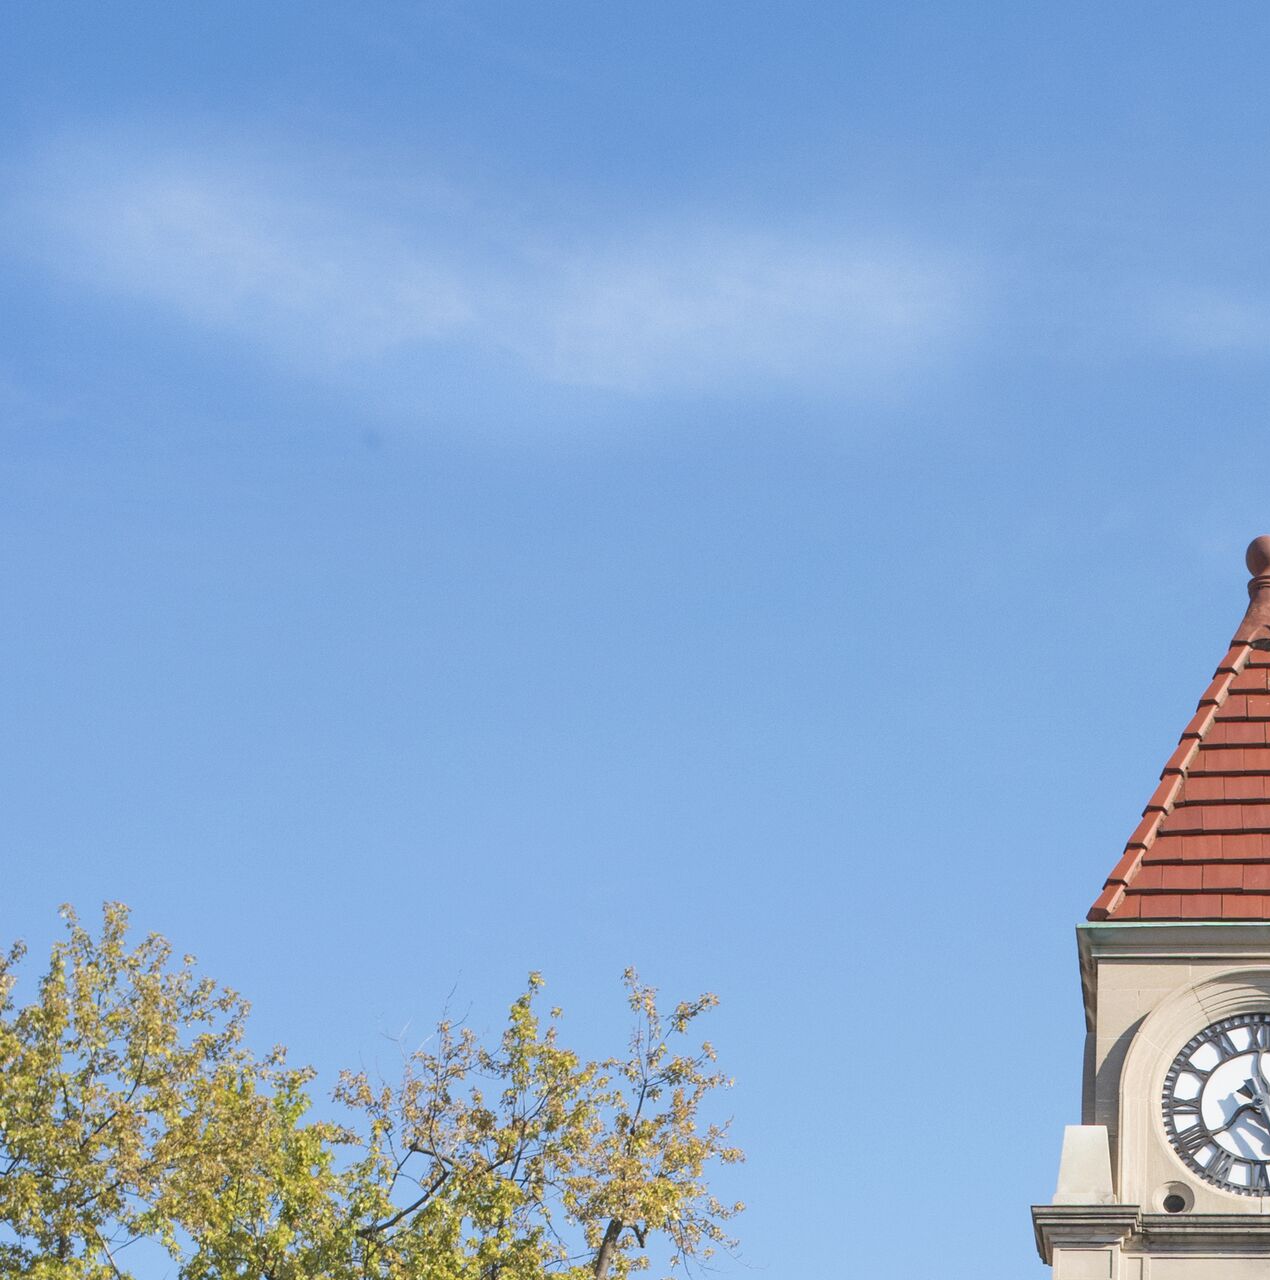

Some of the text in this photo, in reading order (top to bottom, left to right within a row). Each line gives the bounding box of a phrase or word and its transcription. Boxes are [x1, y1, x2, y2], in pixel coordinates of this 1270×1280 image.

[1211, 1032, 1238, 1060] XI
[1180, 1061, 1210, 1081] X
[1172, 1098, 1200, 1115] IX
[1178, 1123, 1212, 1155] VIII
[1206, 1149, 1234, 1183] VII
[1250, 1162, 1270, 1188] VI
